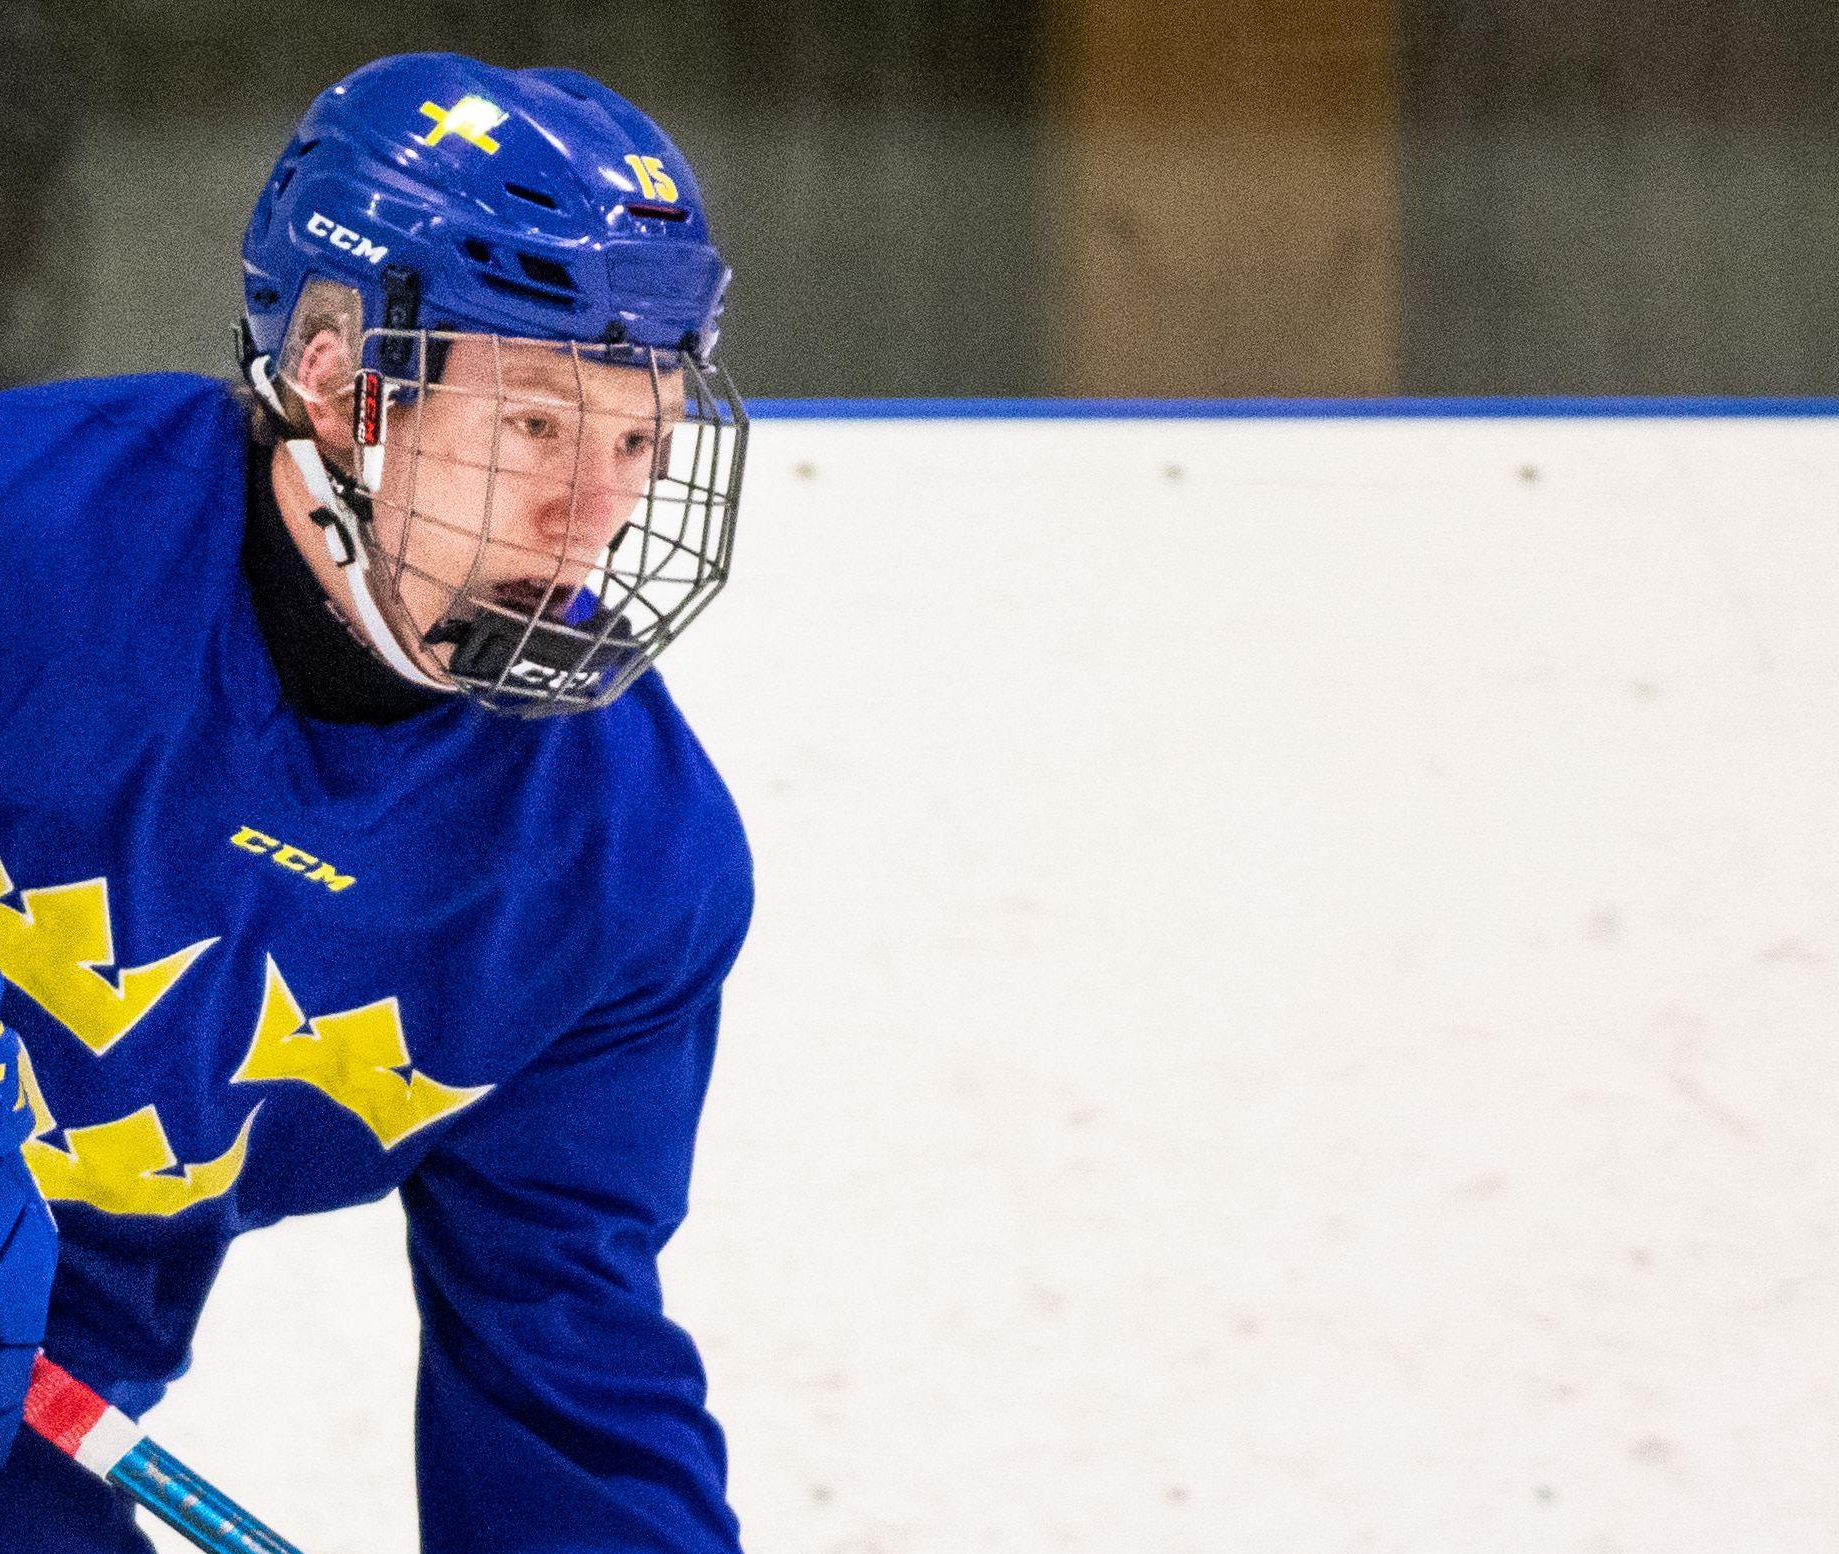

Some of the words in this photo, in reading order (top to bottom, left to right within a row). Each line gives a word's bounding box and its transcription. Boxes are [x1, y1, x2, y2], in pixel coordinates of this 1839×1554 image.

[624, 154, 678, 203] 15
[307, 211, 388, 264] CCM
[229, 825, 357, 893] CCM
